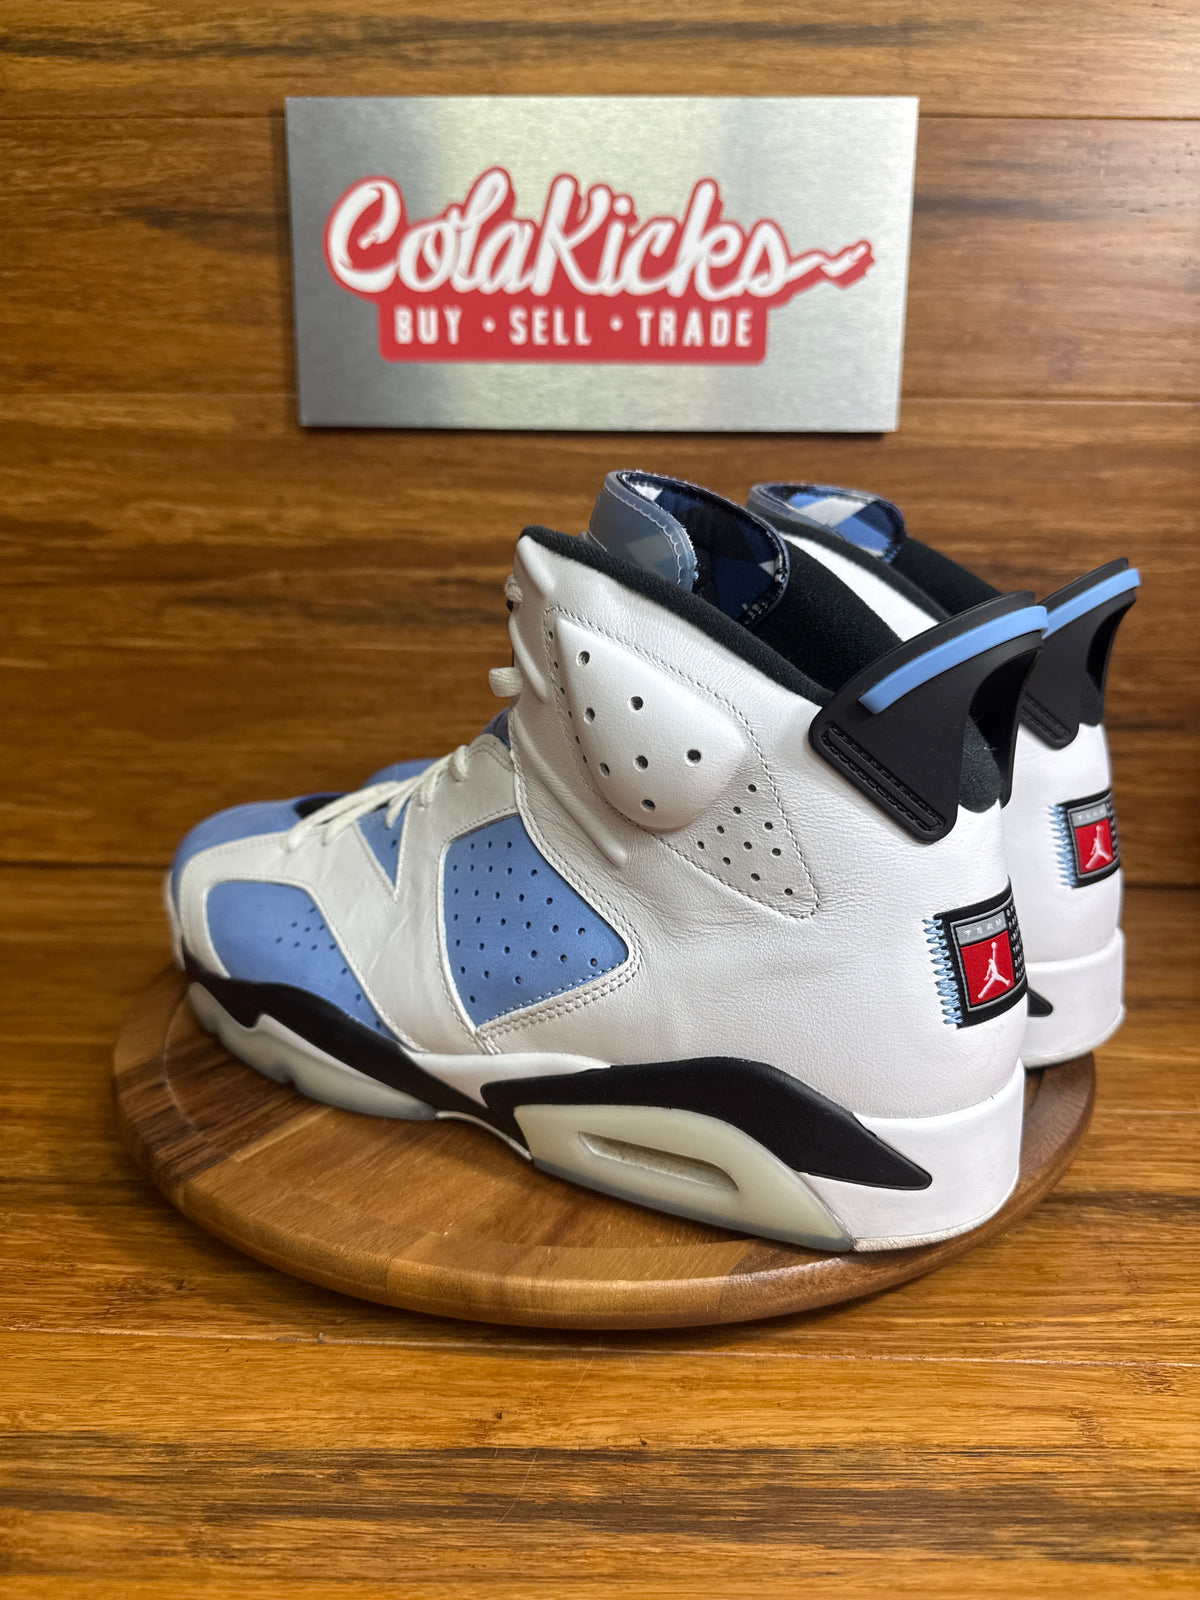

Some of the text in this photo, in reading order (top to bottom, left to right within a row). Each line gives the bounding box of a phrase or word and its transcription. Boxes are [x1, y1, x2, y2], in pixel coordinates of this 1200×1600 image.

[326, 166, 870, 300] ColaKicks
[395, 306, 752, 346] BUY SELL TRADE
[963, 918, 1002, 937] TEAM
